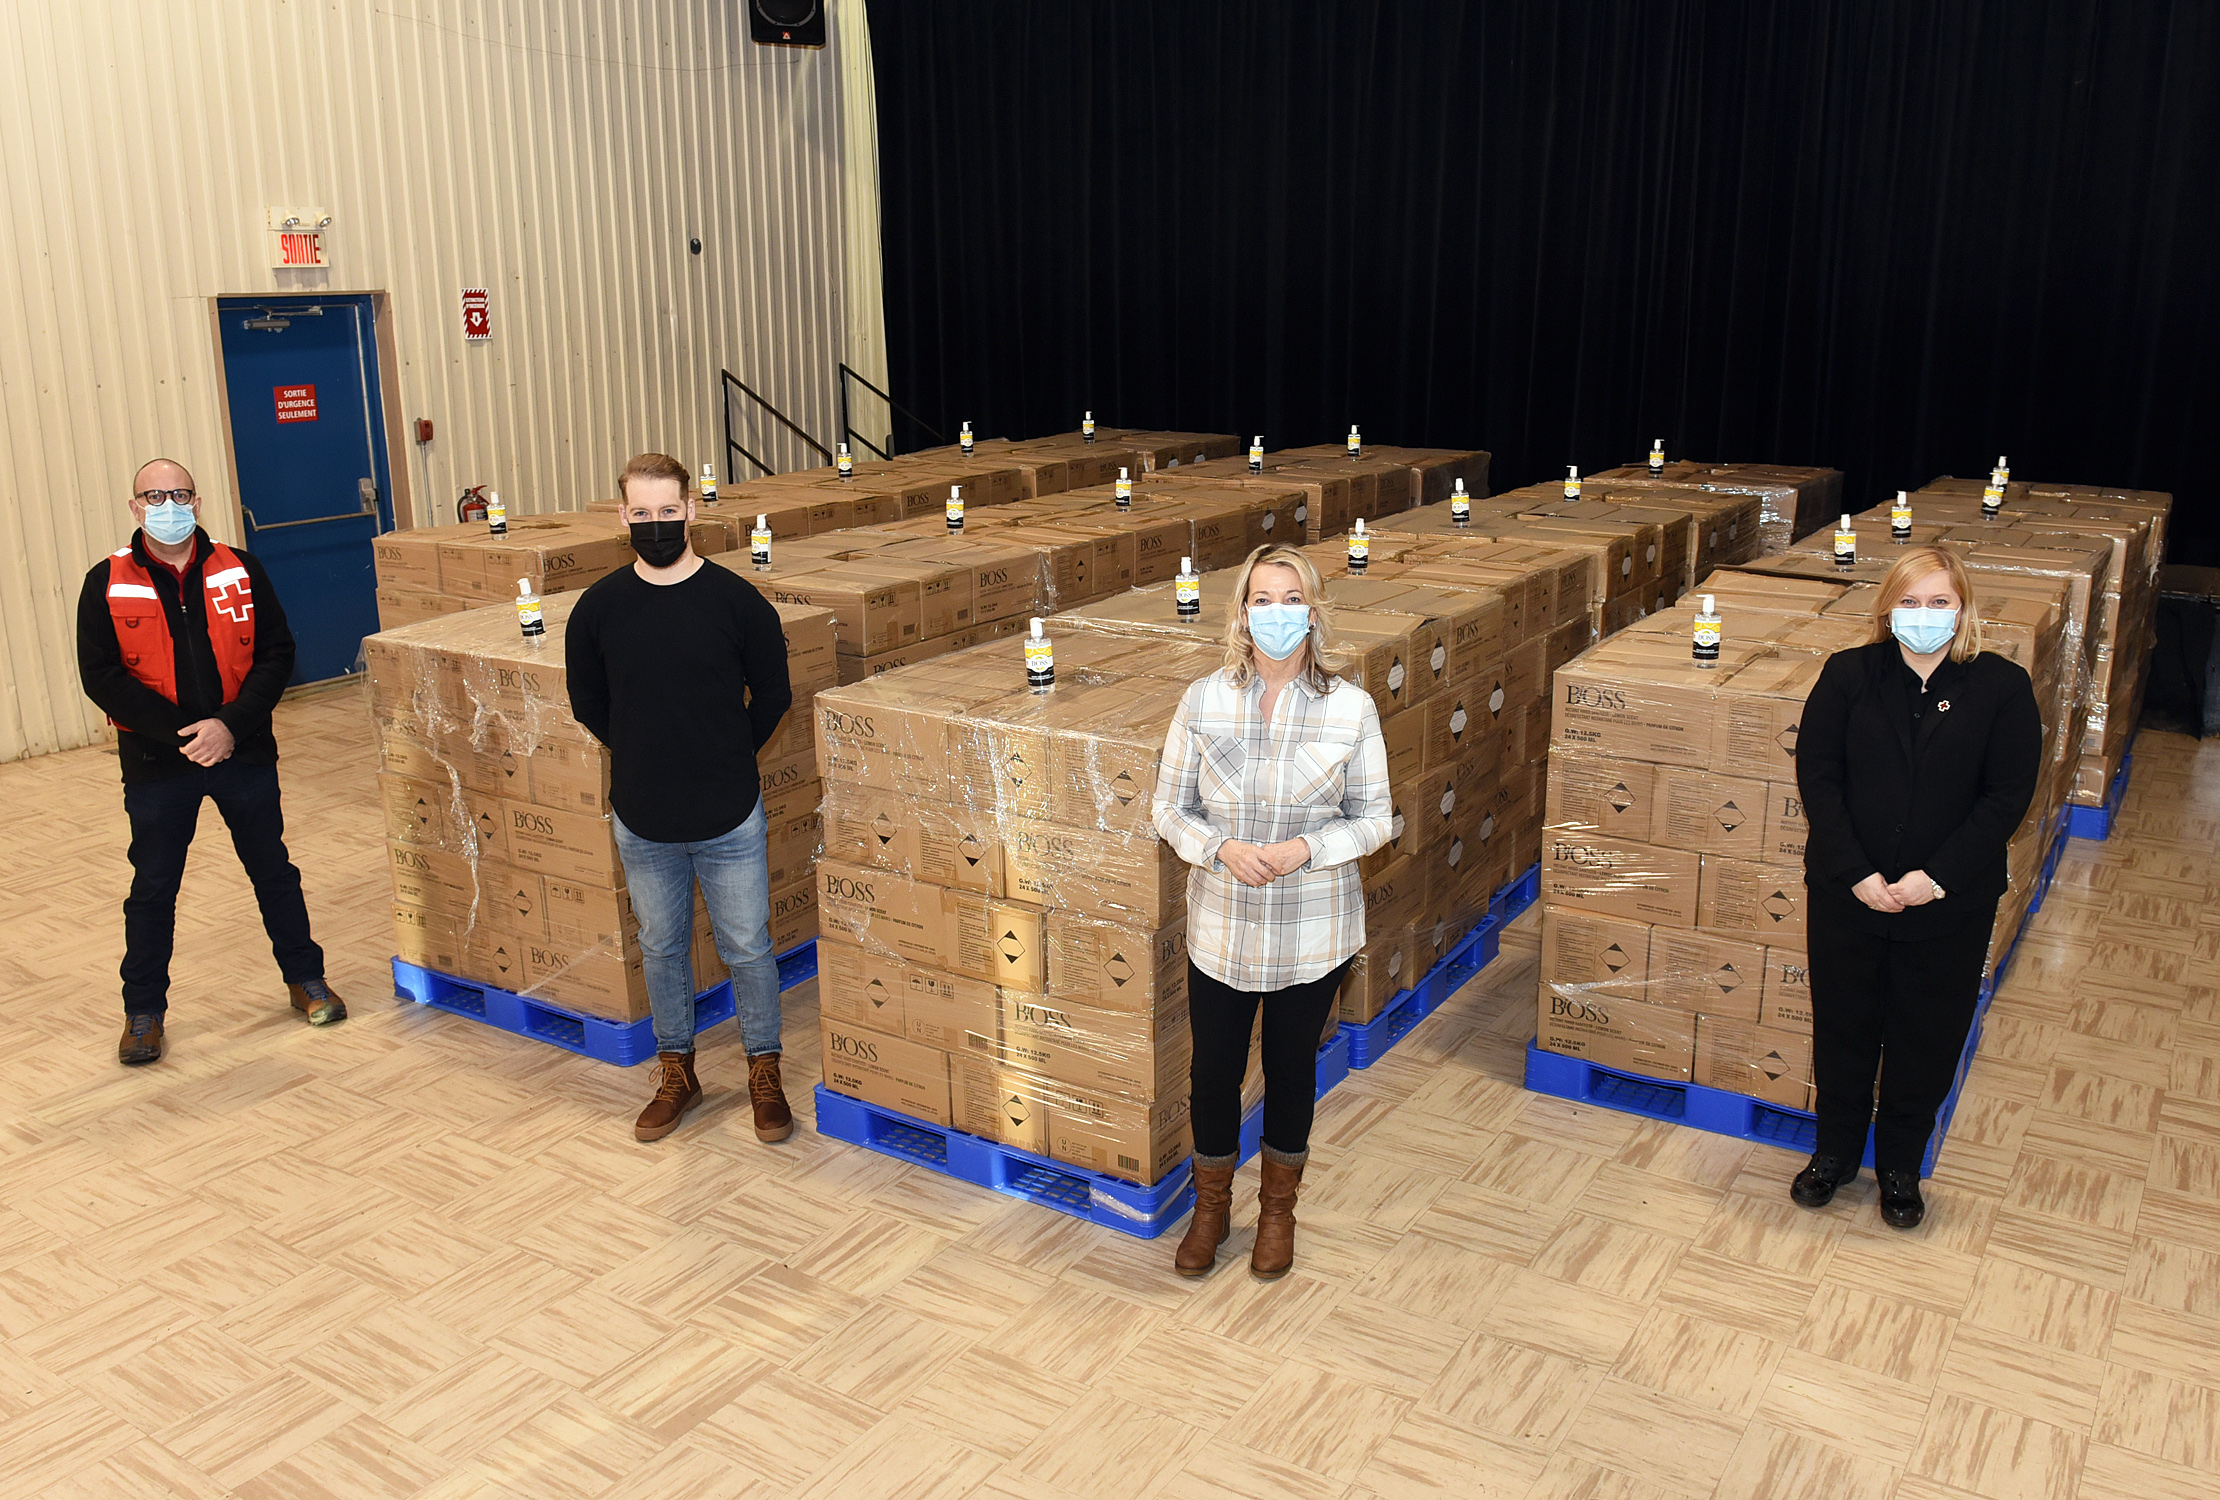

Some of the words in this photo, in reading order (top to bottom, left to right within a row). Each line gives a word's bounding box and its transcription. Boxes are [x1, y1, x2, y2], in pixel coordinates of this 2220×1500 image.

[281, 234, 321, 264] SORTIE
[284, 389, 307, 398] SORTIE
[278, 399, 315, 409] D'URGENCE
[278, 410, 316, 419] SEULEMENT
